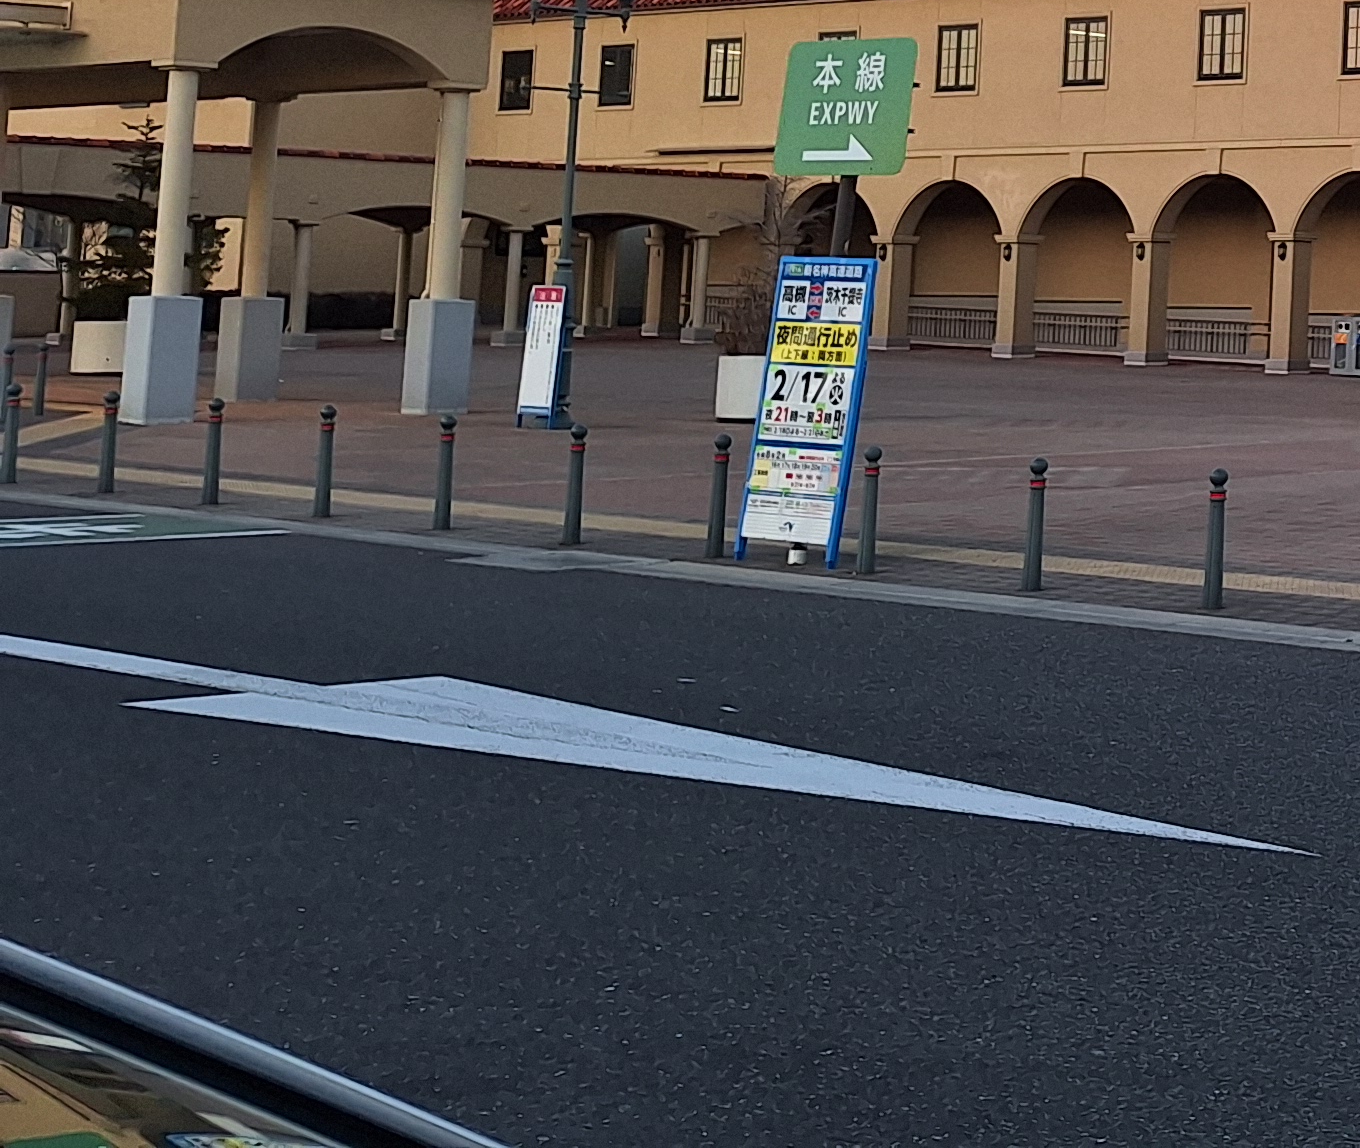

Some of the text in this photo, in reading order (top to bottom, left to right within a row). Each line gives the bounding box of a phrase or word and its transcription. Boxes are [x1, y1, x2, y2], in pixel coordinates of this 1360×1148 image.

[812, 52, 887, 94] 本線
[809, 100, 879, 125] EXPWY
[787, 305, 797, 315] IC
[838, 307, 848, 317] IC
[776, 324, 858, 349] 夜間通行止め
[771, 369, 828, 404] 2/17
